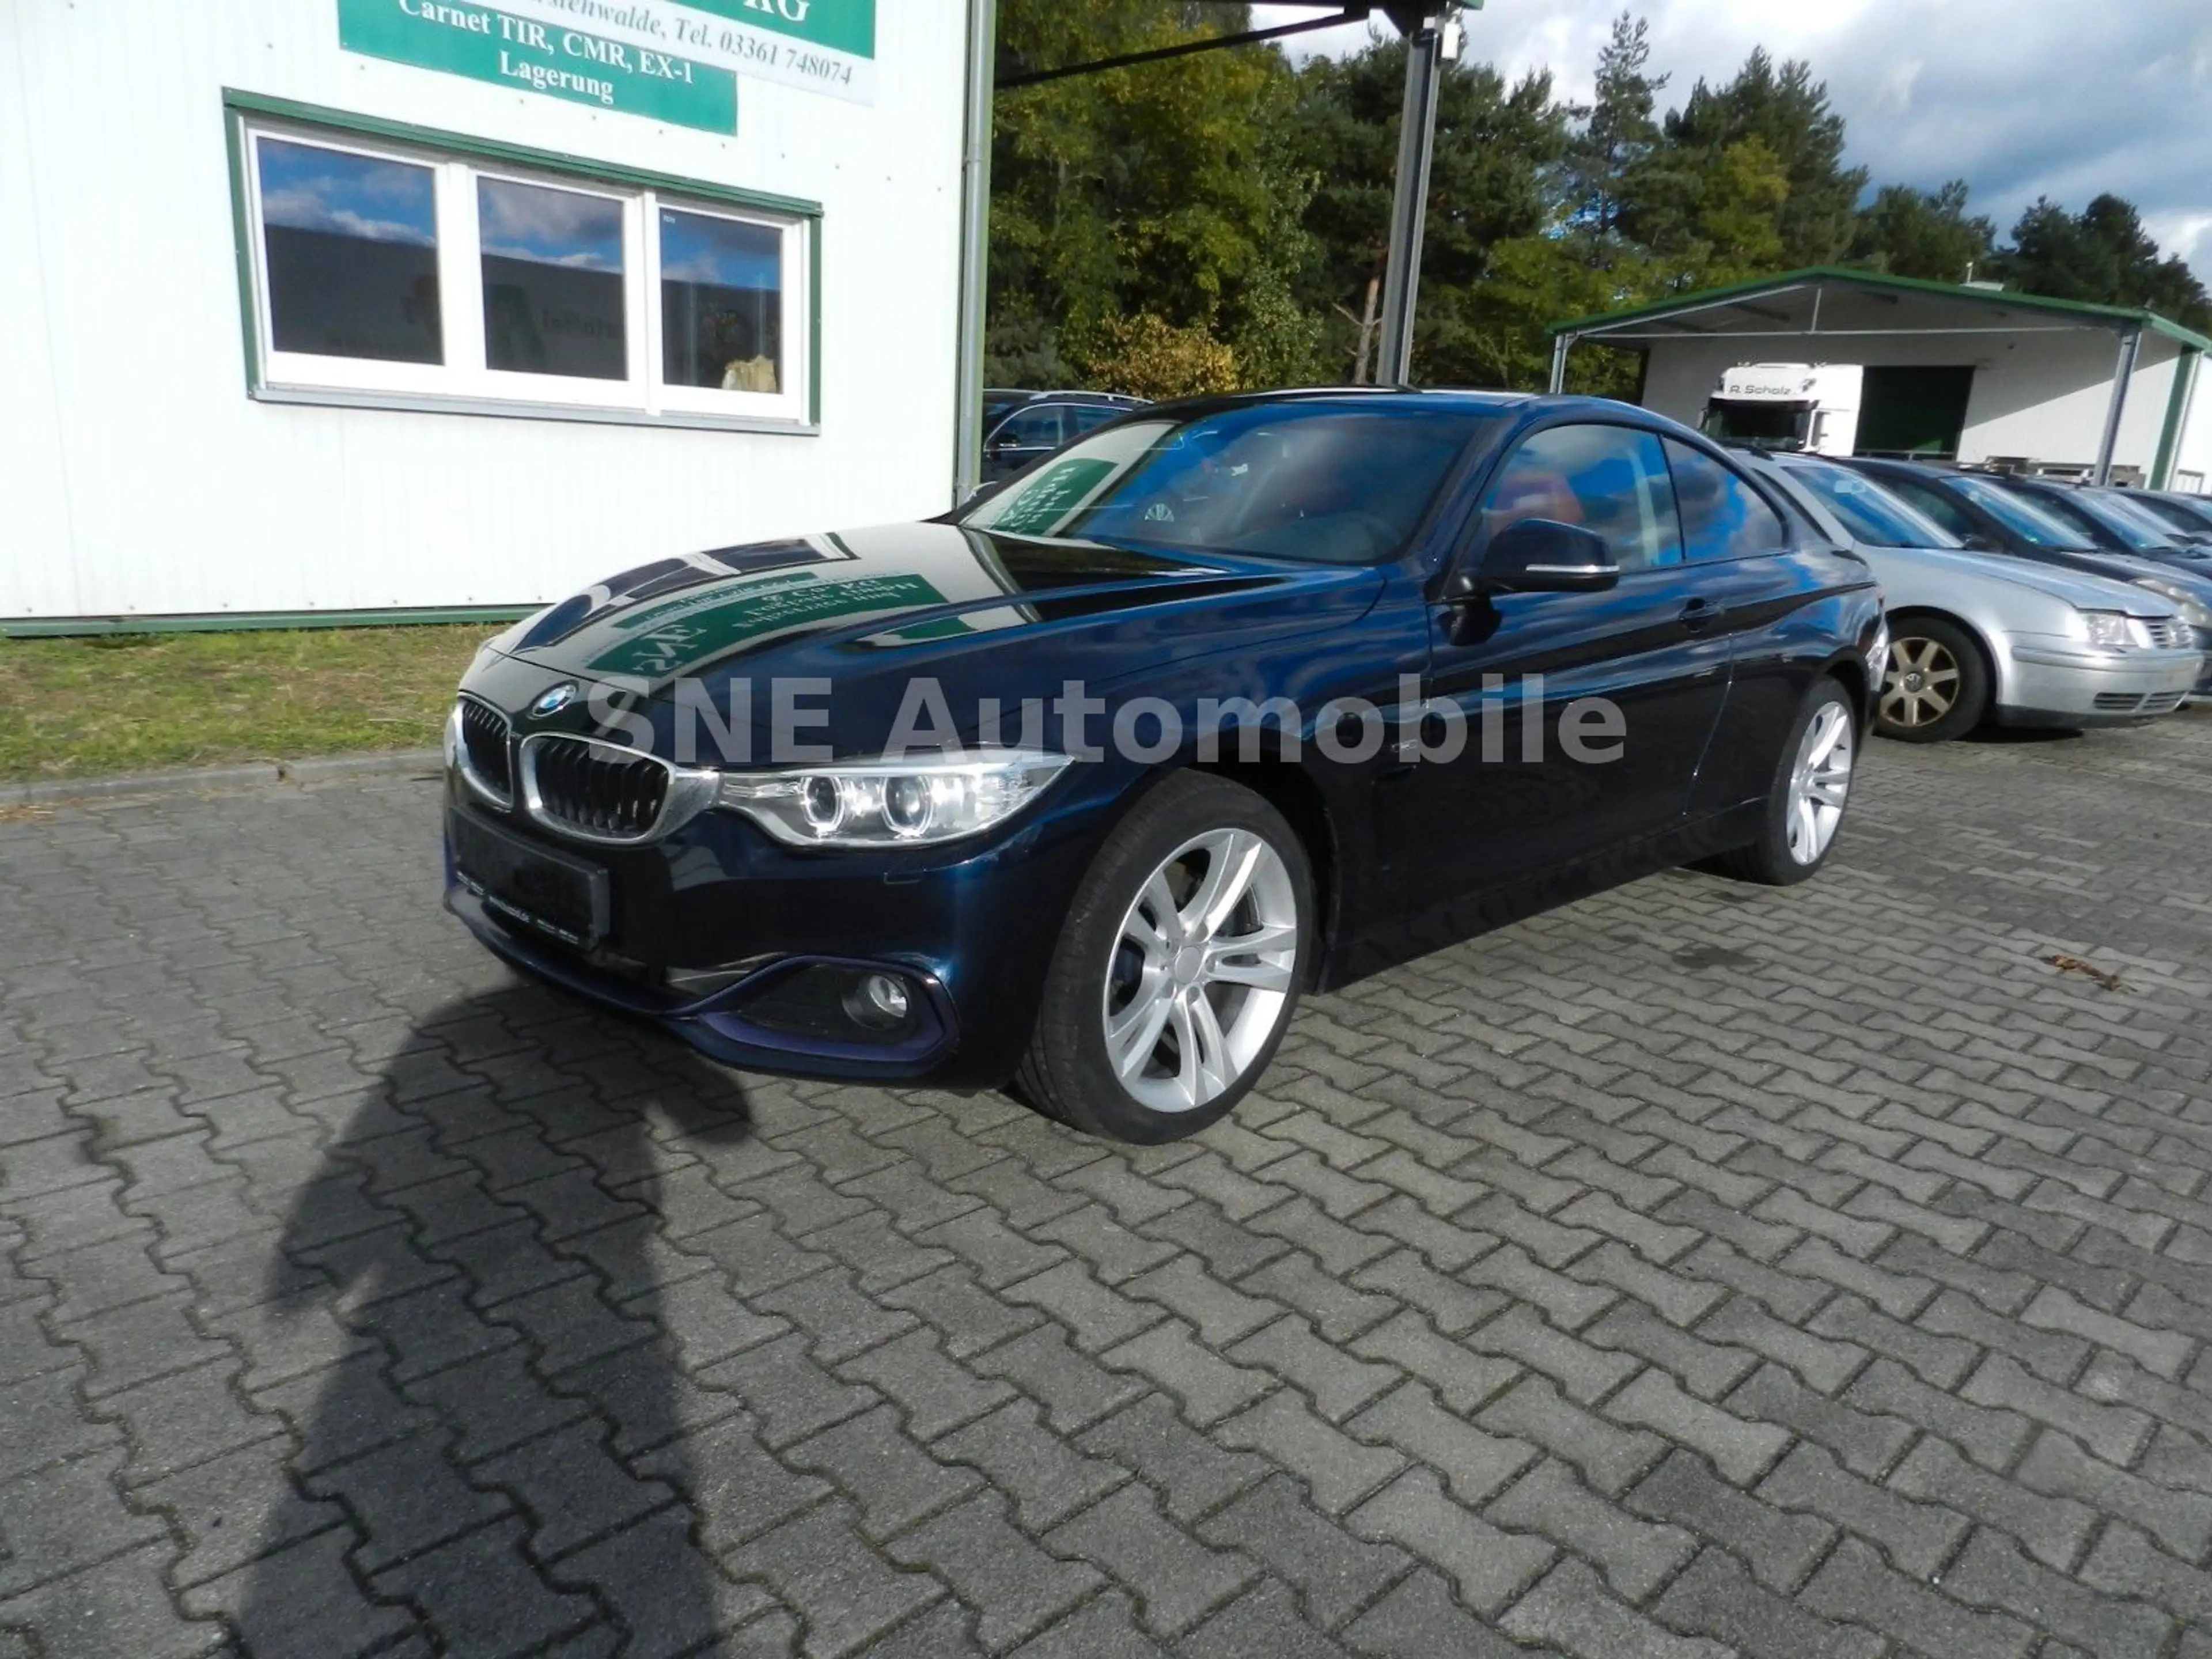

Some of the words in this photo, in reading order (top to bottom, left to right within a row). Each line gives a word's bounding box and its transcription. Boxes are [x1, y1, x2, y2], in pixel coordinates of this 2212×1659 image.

[398, 0, 491, 35] Carnet
[497, 13, 555, 56] TIR,
[562, 31, 633, 74] CMR,
[639, 50, 693, 84] EX-1
[676, 17, 712, 48] Tel.
[719, 31, 778, 66] 03361
[786, 48, 852, 85] 748074
[499, 50, 614, 105] Lagerung
